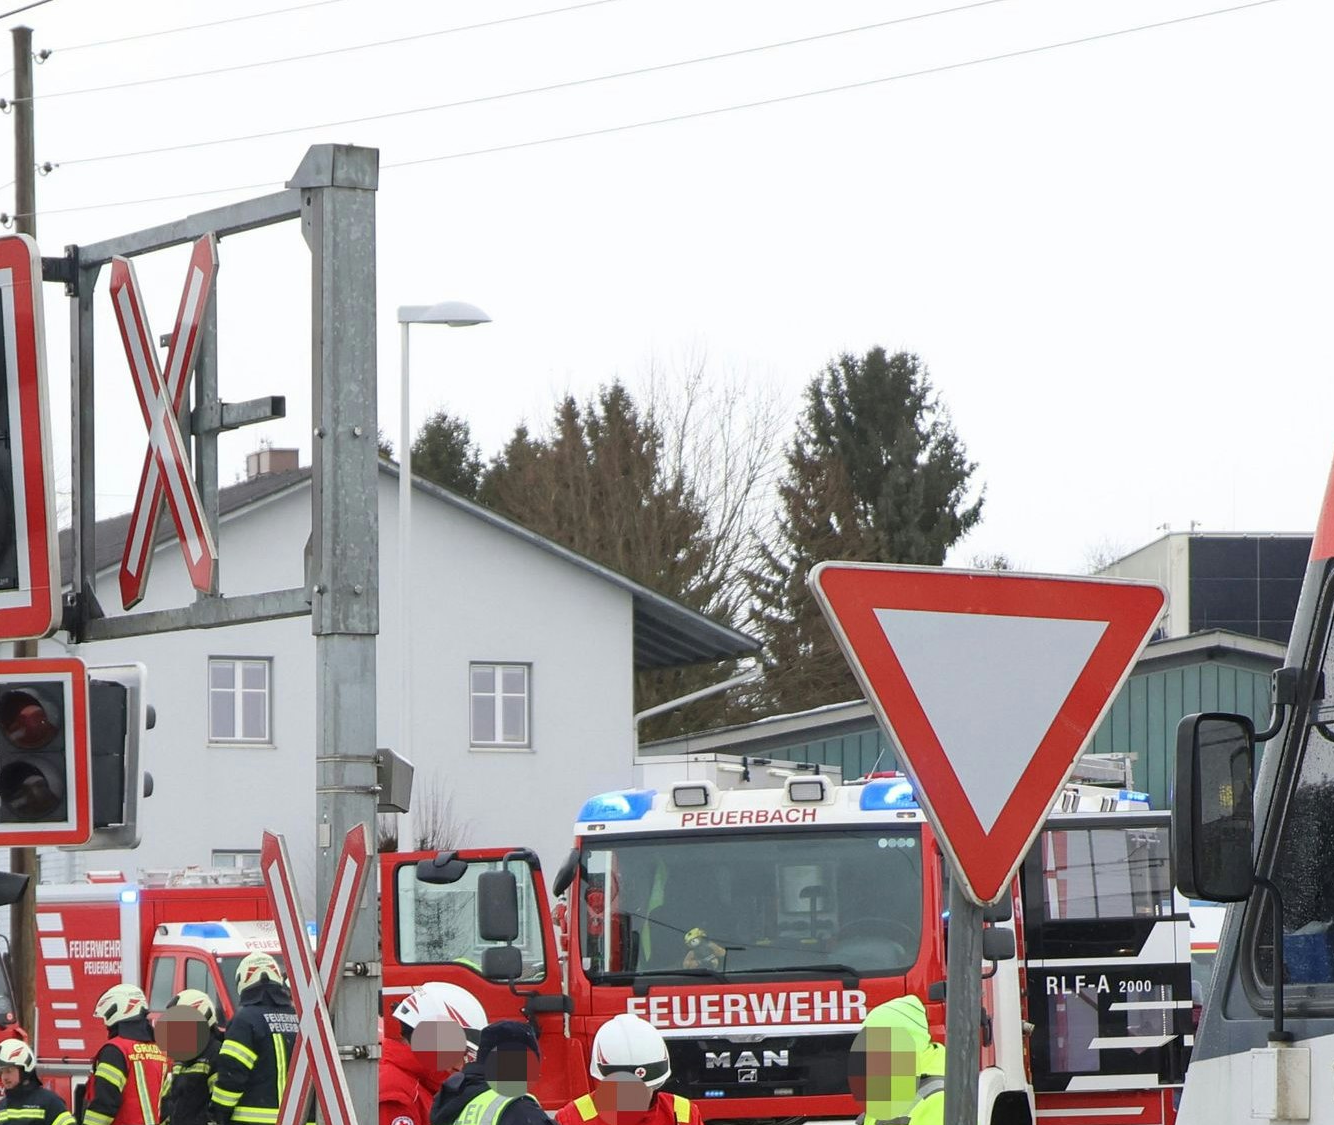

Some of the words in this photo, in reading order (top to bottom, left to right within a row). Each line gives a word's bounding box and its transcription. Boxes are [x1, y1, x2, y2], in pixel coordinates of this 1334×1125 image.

[681, 808, 817, 827] PEUERBACH
[69, 940, 122, 958] FEUERWEHR
[245, 940, 280, 950] PEUER
[84, 960, 122, 975] PEUERBACH
[1046, 975, 1110, 995] RLF-A
[1119, 980, 1152, 993] 2000
[627, 990, 867, 1027] FEUERWEHR
[269, 1023, 299, 1033] PEUERB
[705, 1050, 789, 1068] MAN
